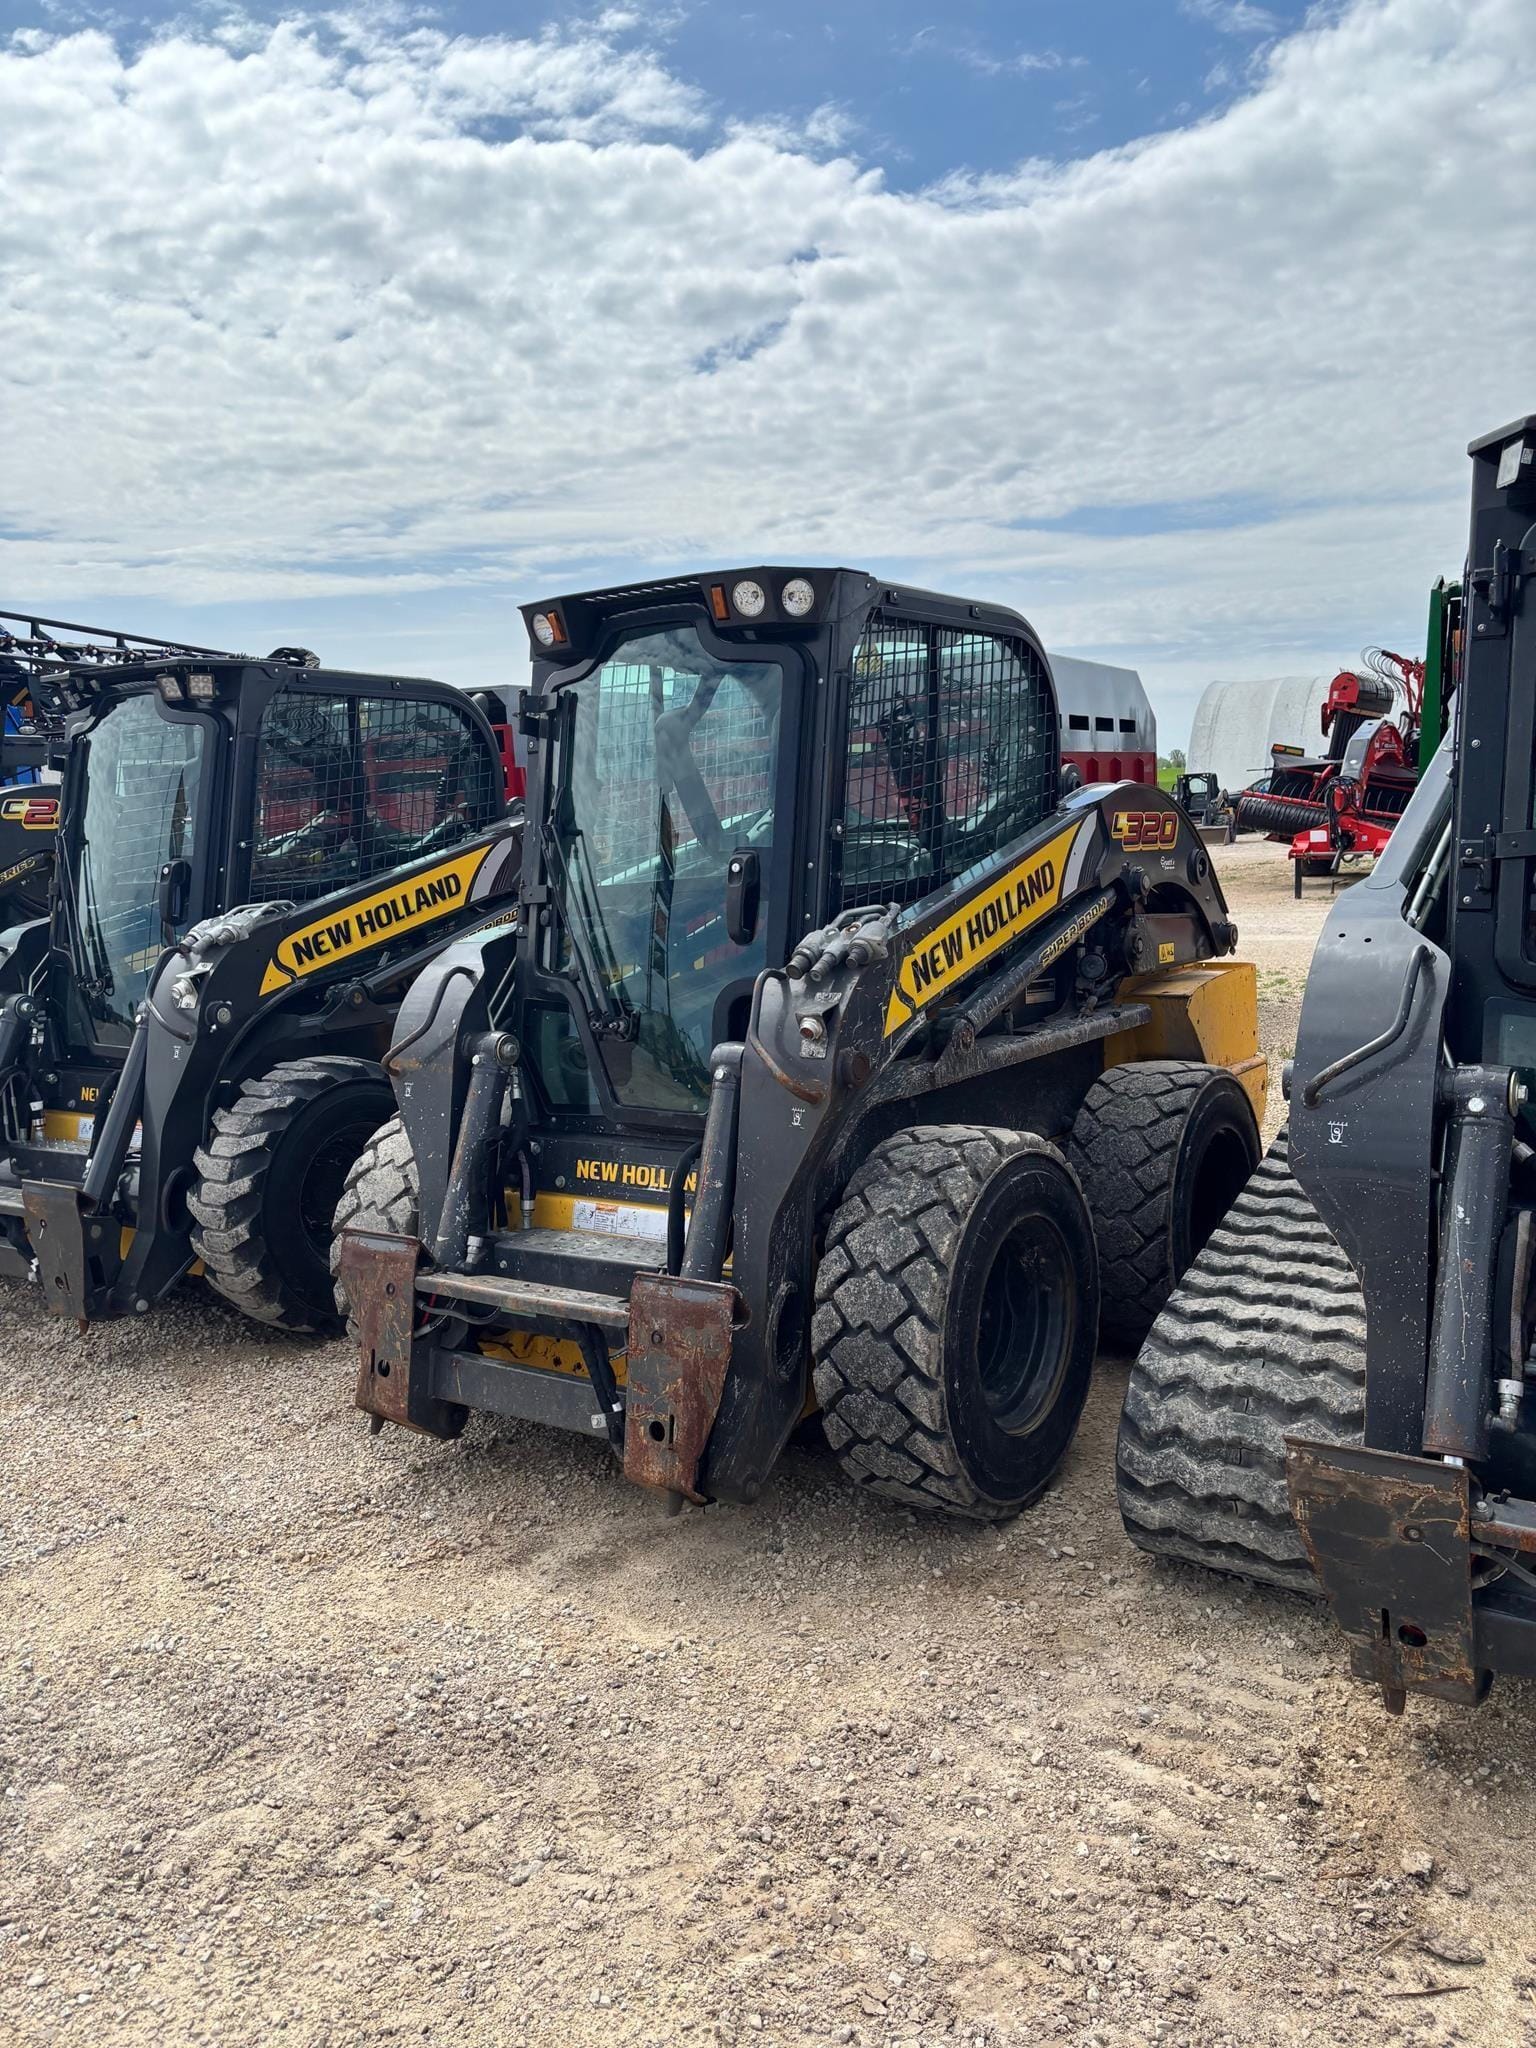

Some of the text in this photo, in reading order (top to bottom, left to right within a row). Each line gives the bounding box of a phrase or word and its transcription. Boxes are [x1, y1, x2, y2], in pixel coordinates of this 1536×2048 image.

[1, 799, 60, 829] C2
[1112, 812, 1178, 852] L320
[291, 872, 462, 967] NEW HOLLAND
[910, 859, 1056, 994] NEW HOLLAND
[1038, 896, 1108, 968] SUPER BOOM
[80, 1086, 100, 1102] NE
[576, 1159, 698, 1193] NEW HOLLN
